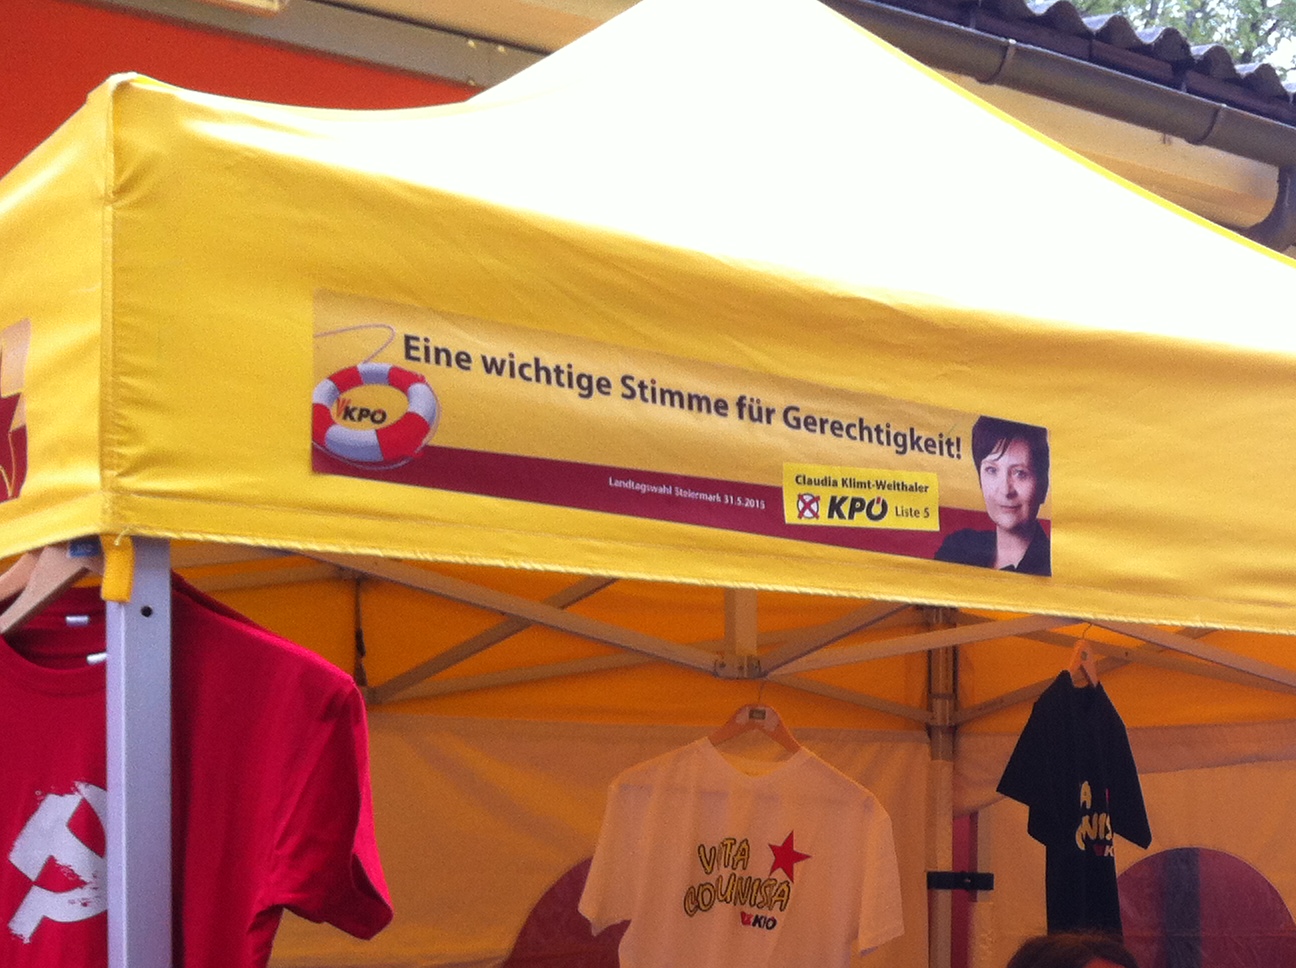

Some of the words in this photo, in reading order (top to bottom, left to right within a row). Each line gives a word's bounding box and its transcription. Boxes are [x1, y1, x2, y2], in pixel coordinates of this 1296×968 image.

[402, 333, 473, 371] Eine
[481, 352, 612, 398] wichtige
[620, 373, 729, 418] Stimme
[736, 395, 777, 426] für
[782, 406, 963, 461] Gerechtigkeit!
[608, 476, 673, 498] Landtagswahl
[674, 485, 721, 504] Steiermark
[795, 474, 838, 489] Claudia
[841, 476, 929, 494] Klimt-Weithaler
[827, 495, 889, 521] KPÖ
[895, 506, 920, 519] Liste
[923, 507, 930, 519] 5
